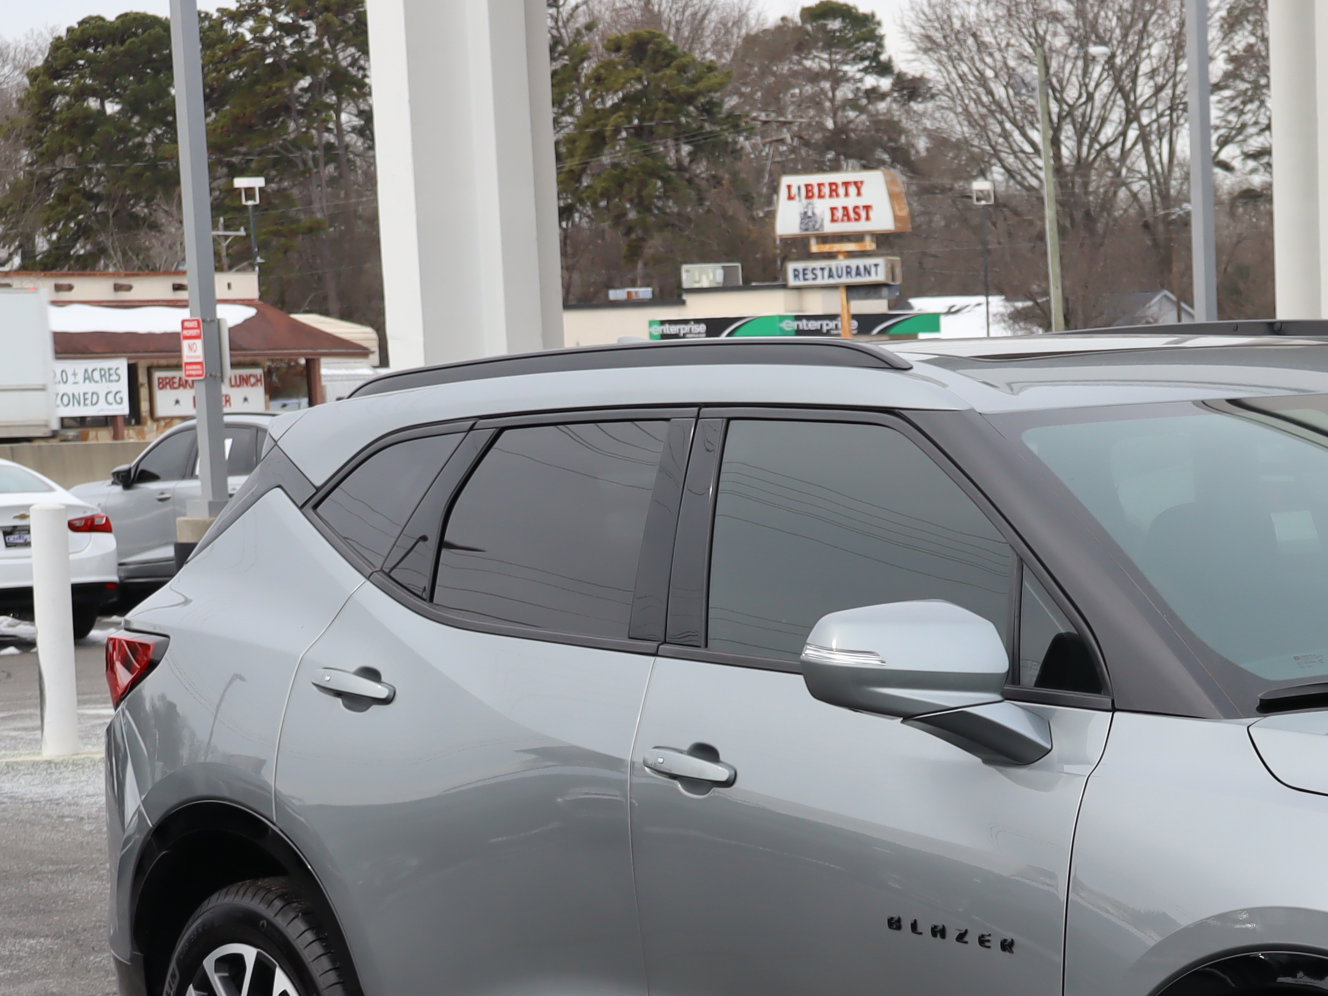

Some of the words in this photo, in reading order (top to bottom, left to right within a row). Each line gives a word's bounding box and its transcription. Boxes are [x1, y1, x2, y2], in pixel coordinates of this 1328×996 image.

[786, 180, 865, 200] LIBERTY
[829, 205, 873, 223] EAST
[792, 263, 881, 281] RESTAURANT
[649, 321, 707, 337] enterprise
[780, 316, 858, 333] enterprie
[83, 367, 121, 384] ACRES
[229, 374, 264, 388] LUNCH
[105, 390, 123, 406] CG
[887, 915, 1016, 954] BLAZER
